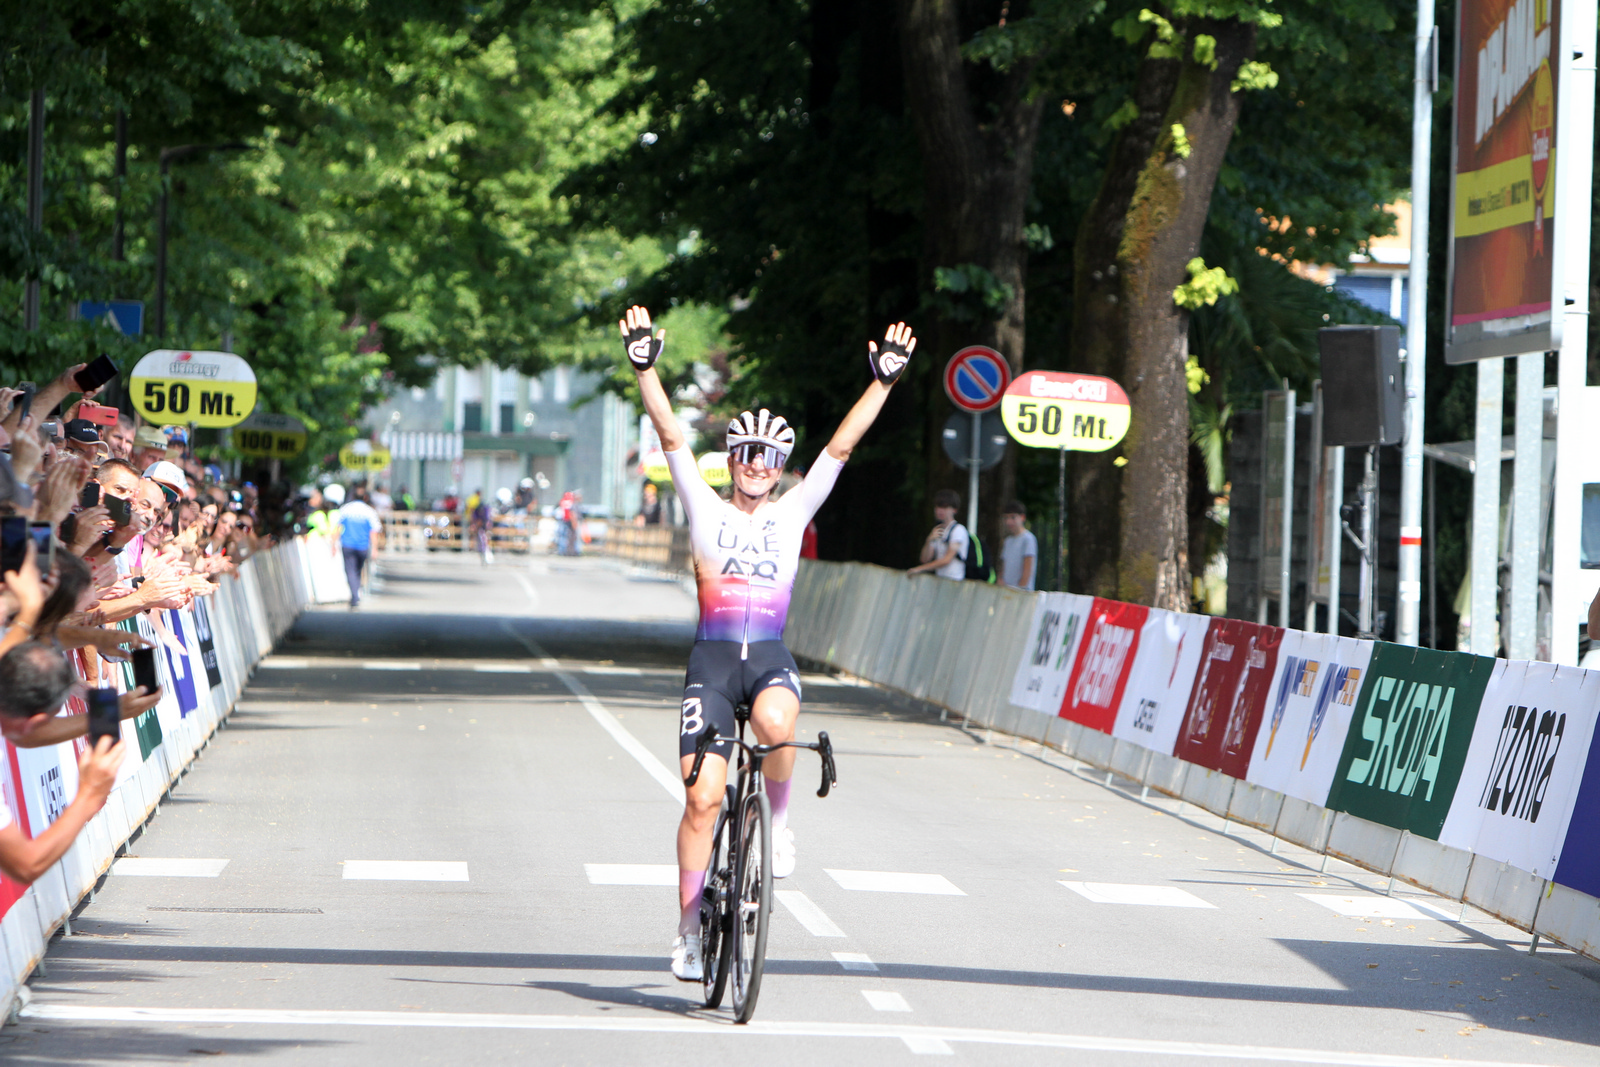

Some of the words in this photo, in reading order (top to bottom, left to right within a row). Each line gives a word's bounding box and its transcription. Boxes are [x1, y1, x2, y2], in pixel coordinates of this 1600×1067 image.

[144, 381, 190, 413] 50
[200, 390, 241, 416] Mt.
[1017, 402, 1062, 435] 50
[1073, 414, 1113, 440] Mt.
[239, 430, 273, 449] 100
[717, 528, 780, 554] UAE
